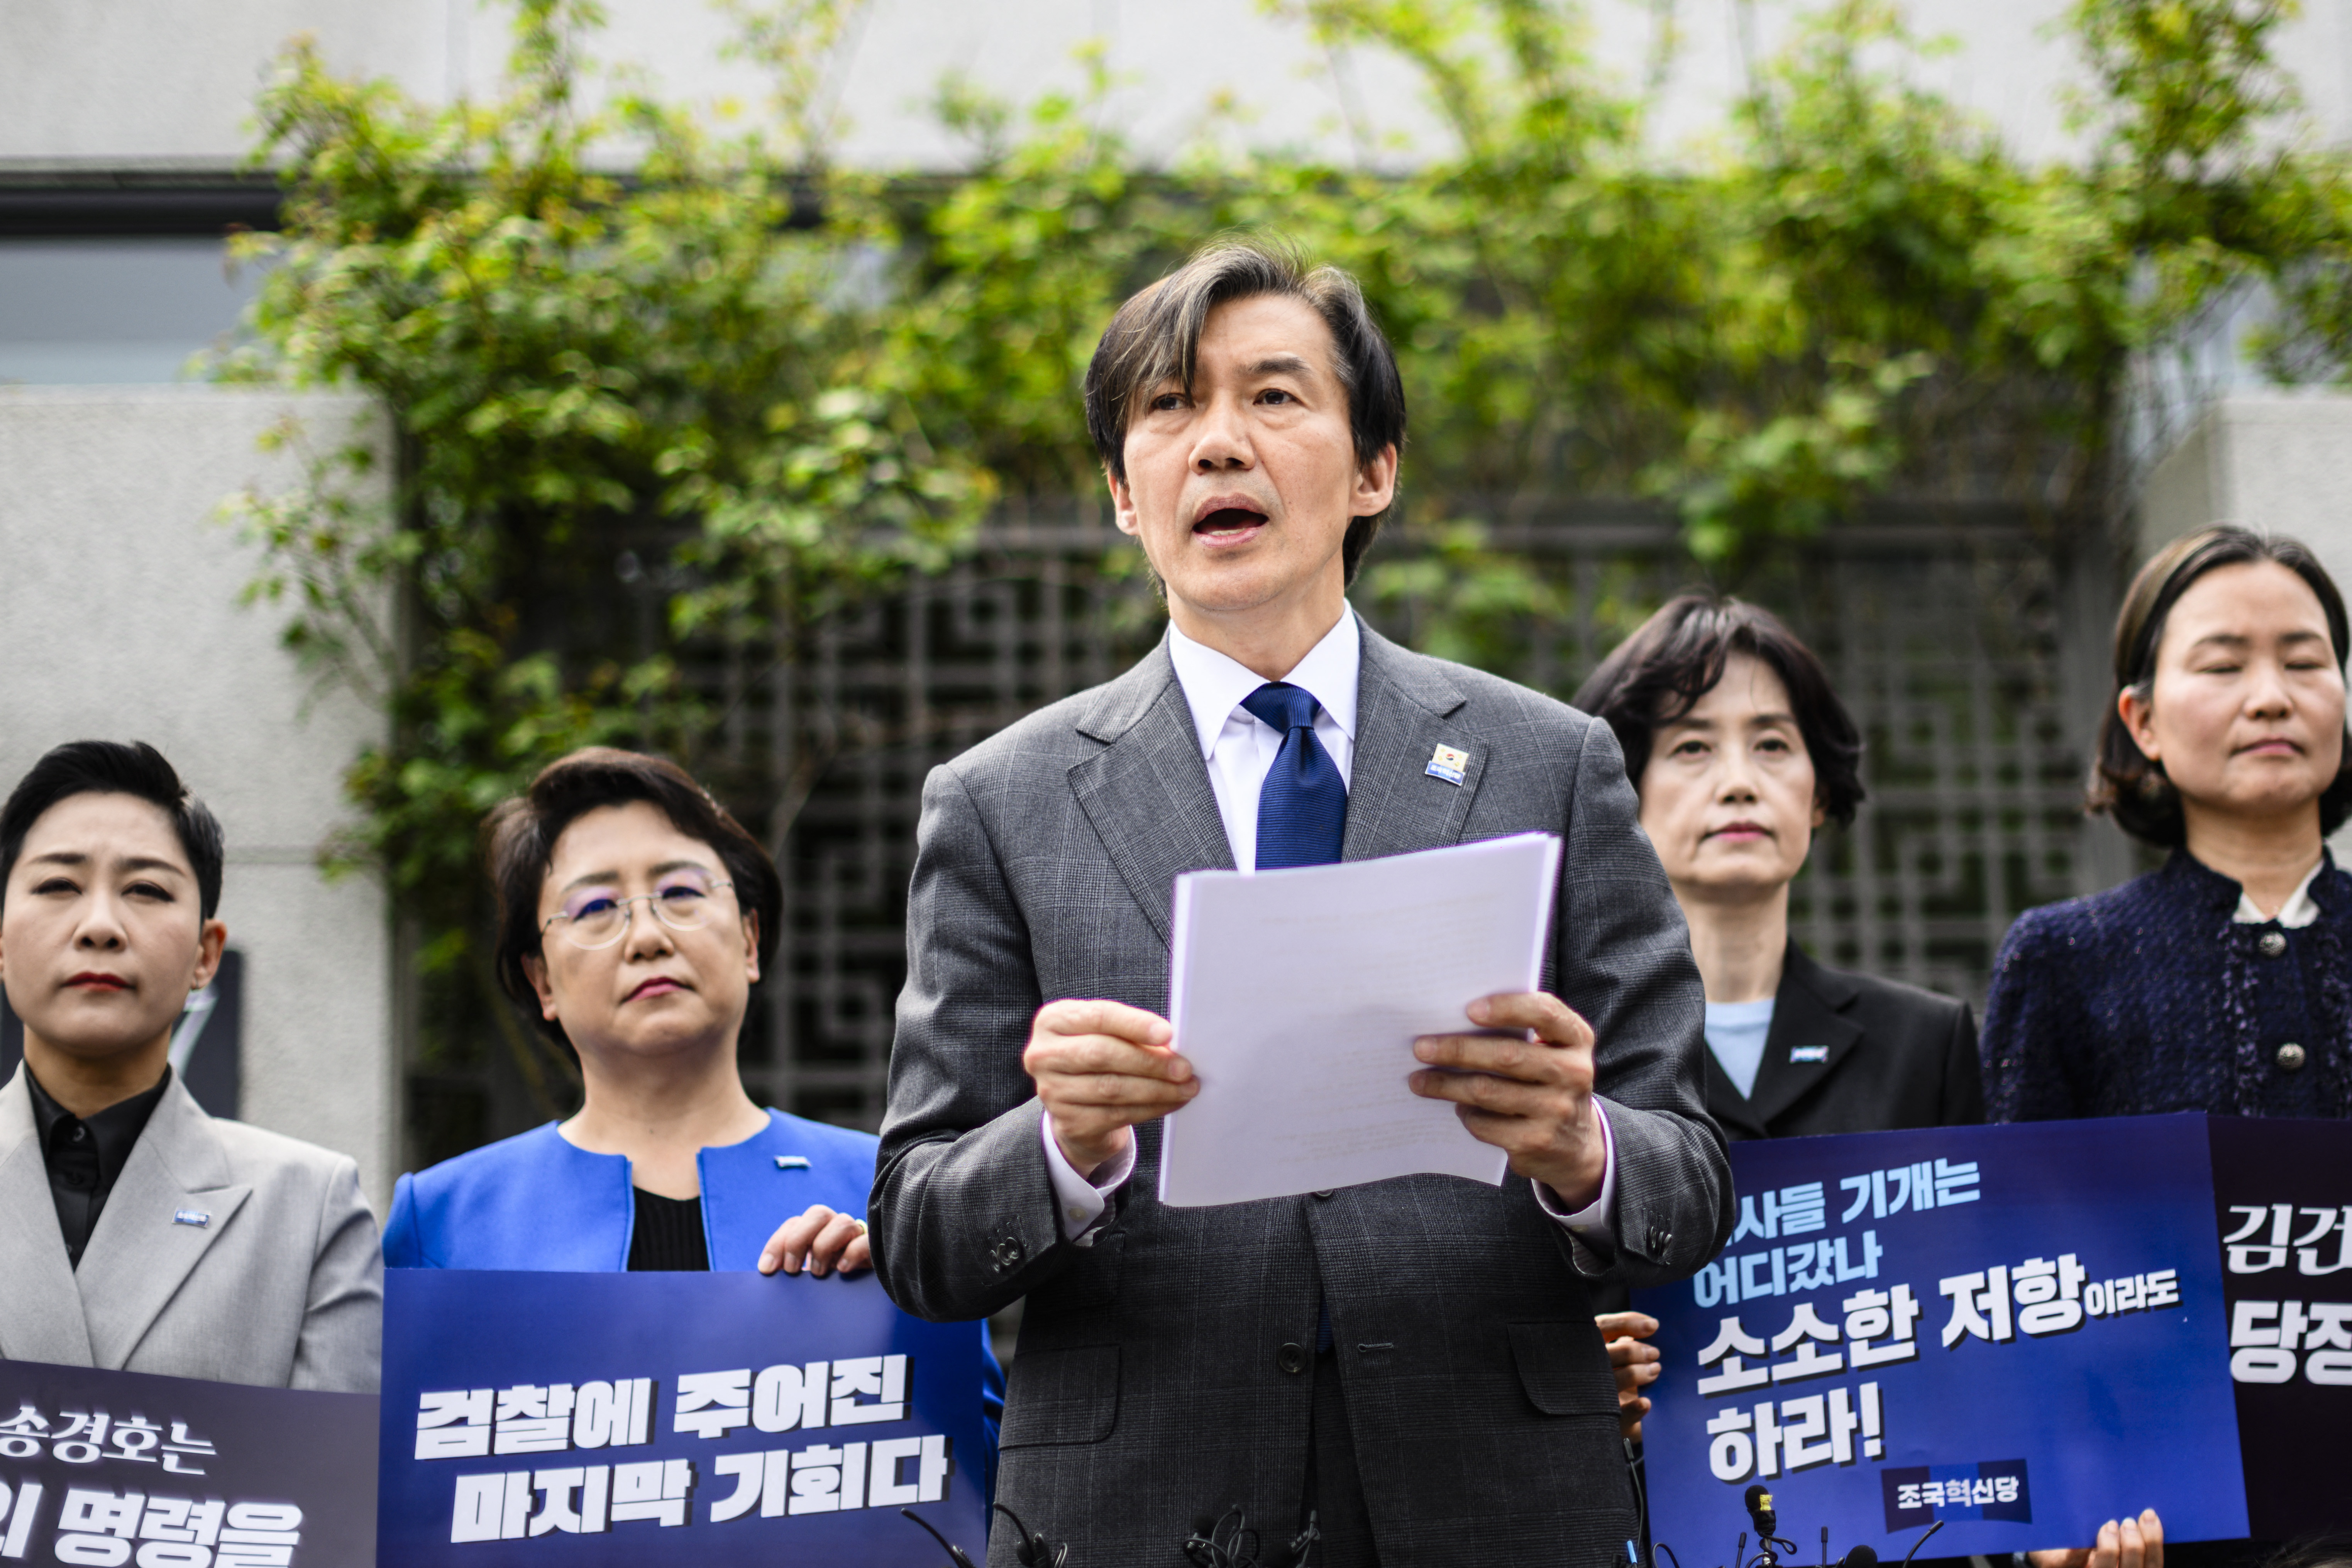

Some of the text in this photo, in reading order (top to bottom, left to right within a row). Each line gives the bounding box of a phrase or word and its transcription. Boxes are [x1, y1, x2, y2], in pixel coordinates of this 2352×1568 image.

[1725, 1157, 1981, 1246] 사들 기개는
[1693, 1229, 1883, 1308] 어디갔나
[1698, 1253, 2179, 1395] 소소한 저항이라도
[0, 1405, 217, 1475] 송경호는
[414, 1354, 908, 1460] 검찰에 주어진
[1706, 1381, 1882, 1482] 하라!
[54, 1487, 303, 1568] 명령을
[450, 1434, 948, 1543] 마지막 기회다
[1897, 1476, 2019, 1509] 조국혁신당
